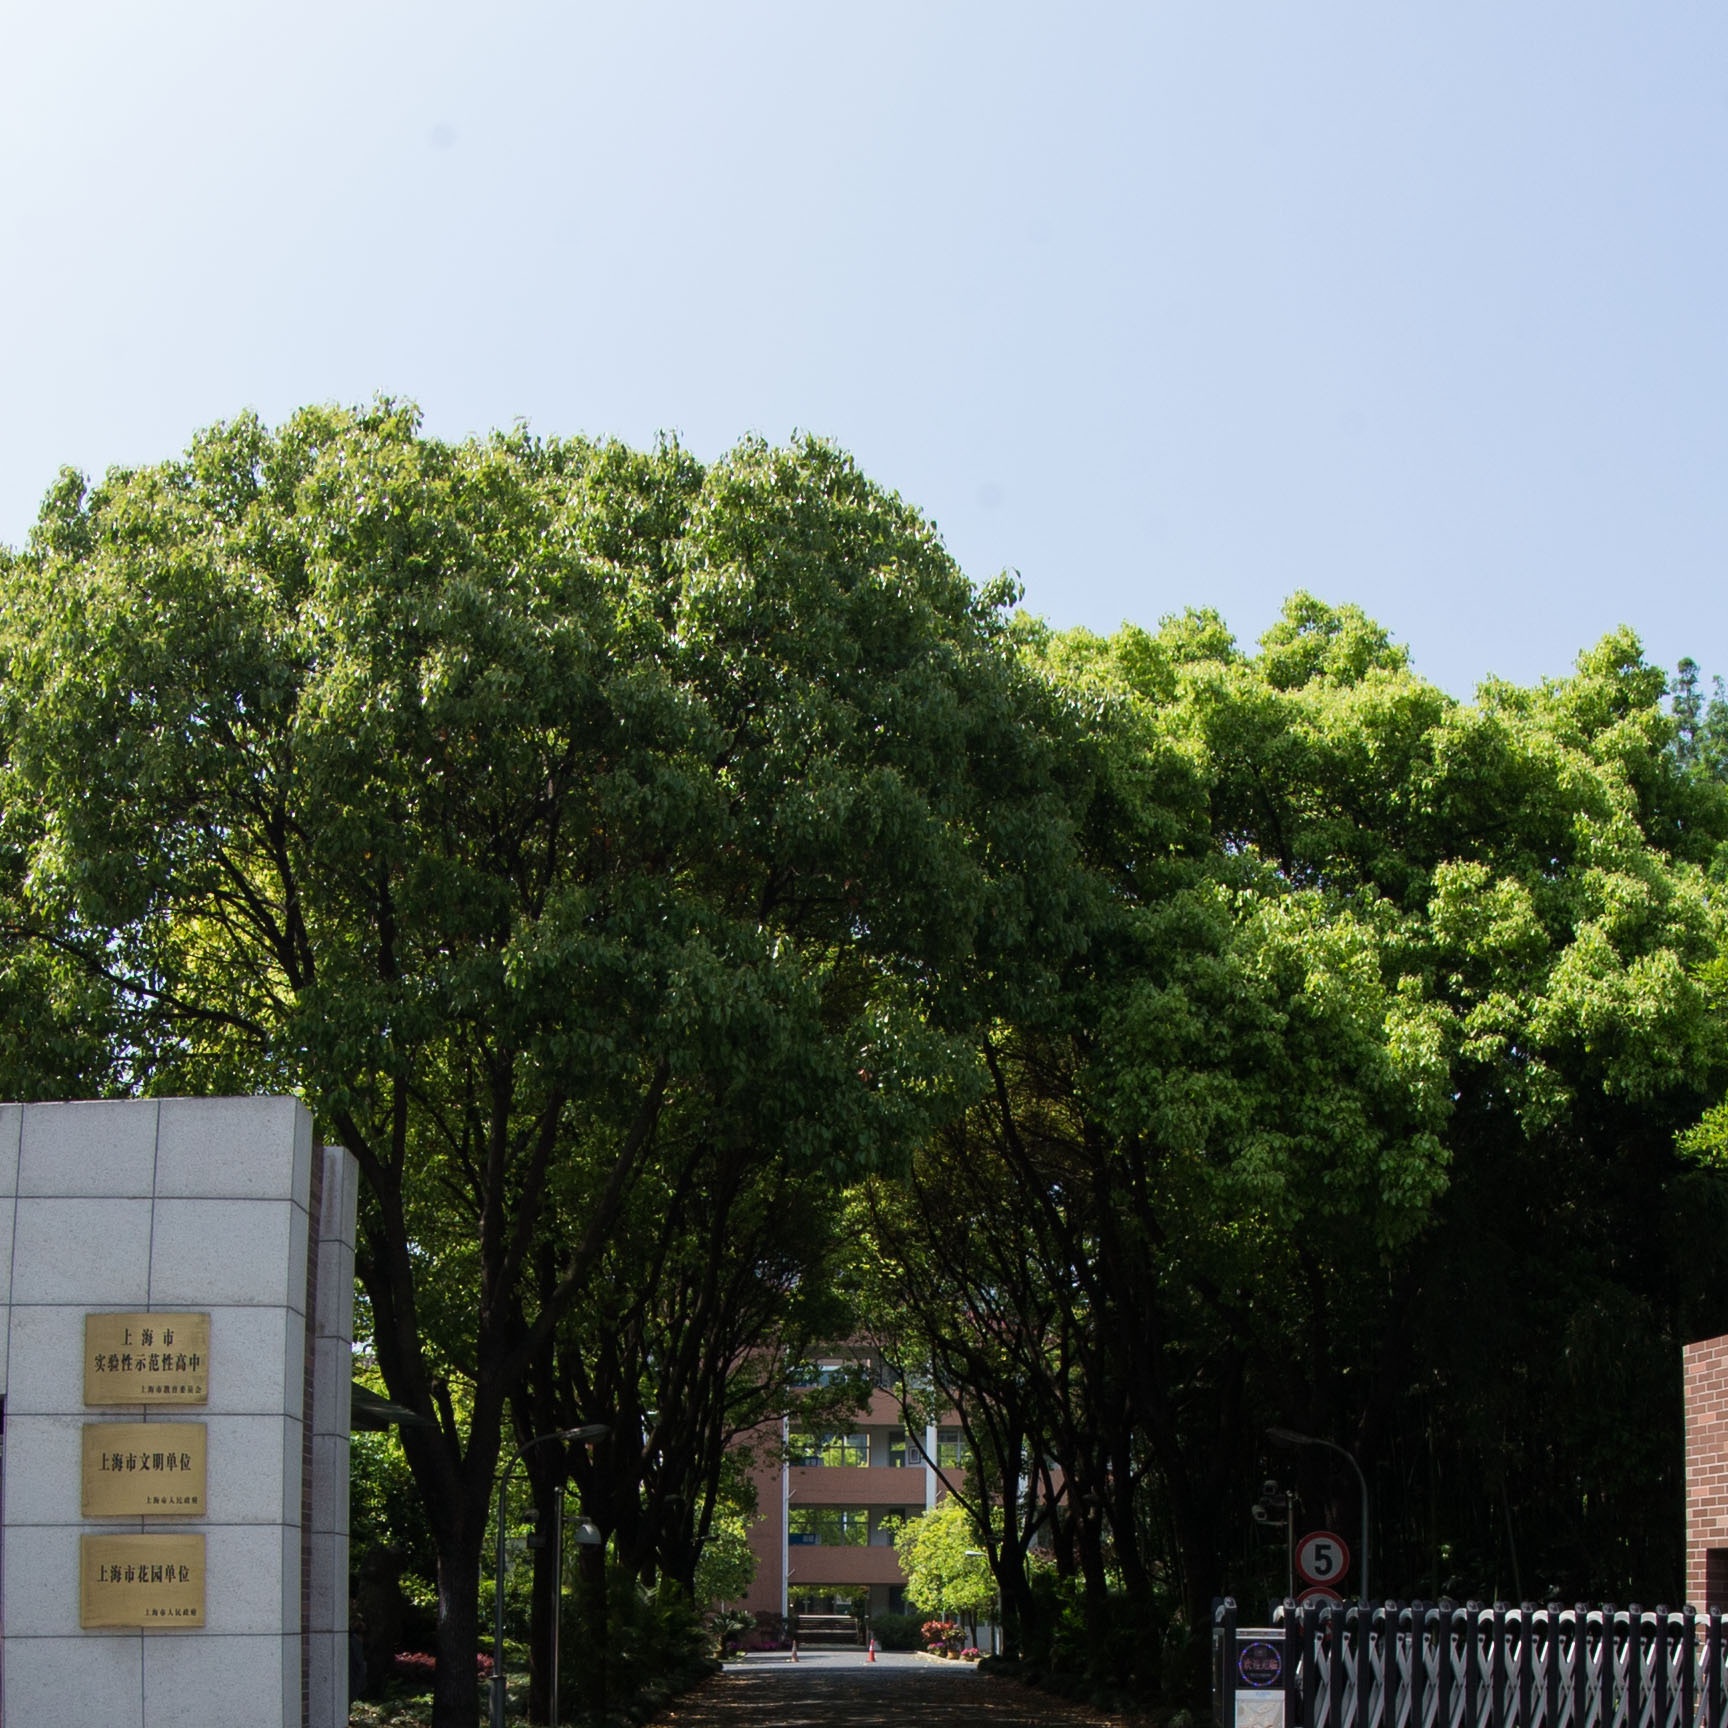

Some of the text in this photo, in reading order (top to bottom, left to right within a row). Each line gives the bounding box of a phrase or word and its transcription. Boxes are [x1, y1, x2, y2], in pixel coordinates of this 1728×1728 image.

[121, 1328, 174, 1346] 上海市
[94, 1353, 200, 1372] 实验性示范性高中
[98, 1452, 191, 1472] 上海市文明单位
[1314, 1544, 1333, 1576] 5
[96, 1564, 191, 1584] 上海市花园单位
